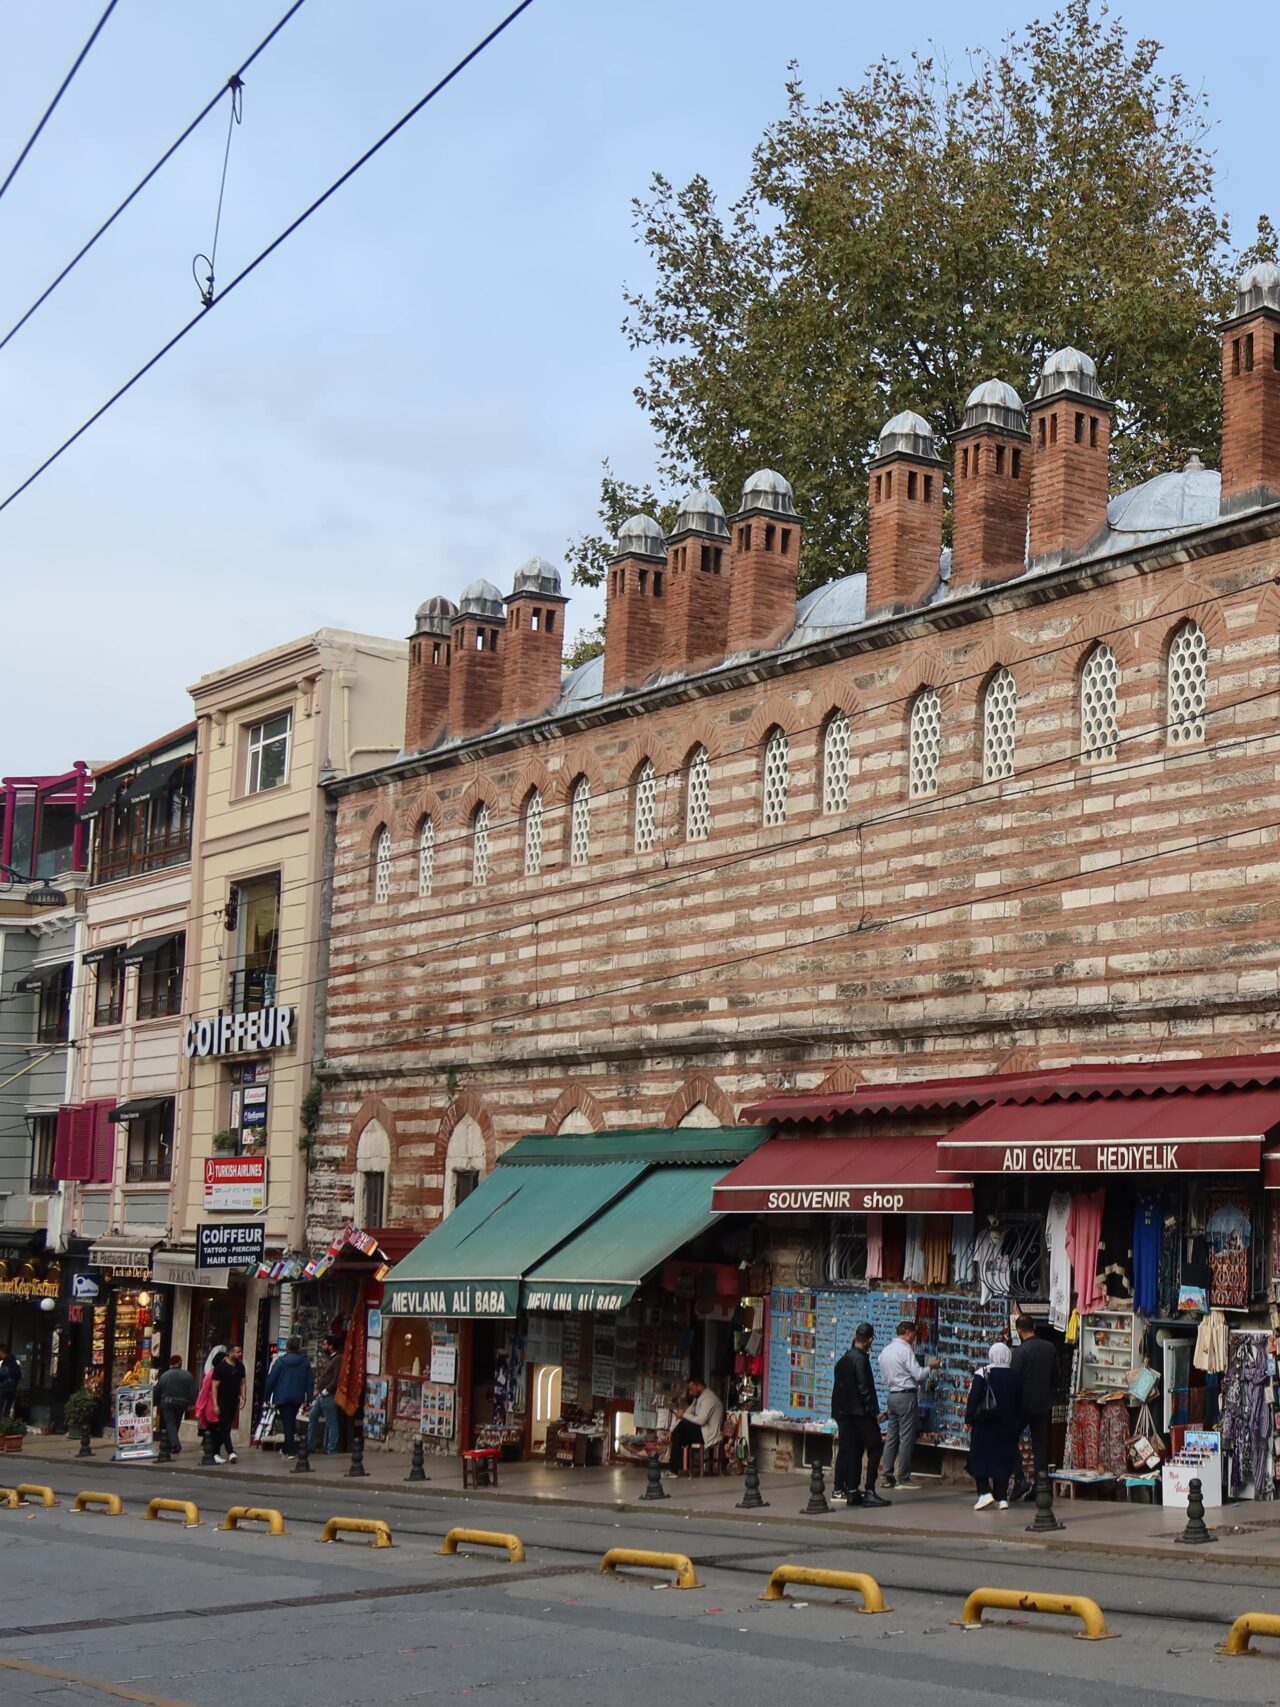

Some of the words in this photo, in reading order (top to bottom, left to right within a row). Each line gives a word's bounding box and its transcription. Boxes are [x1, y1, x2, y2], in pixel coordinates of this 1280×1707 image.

[1002, 1148, 1026, 1171] ADI
[1032, 1147, 1081, 1171] GÜZEL
[215, 1164, 237, 1178] TURKISH
[237, 1163, 262, 1177] AIRLINES
[863, 1191, 904, 1212] shop
[206, 1256, 226, 1265] HAIR
[227, 1255, 257, 1264] DESING
[391, 1291, 446, 1313] MEVLANA
[452, 1285, 470, 1313] ALİ
[475, 1291, 506, 1313] BABA
